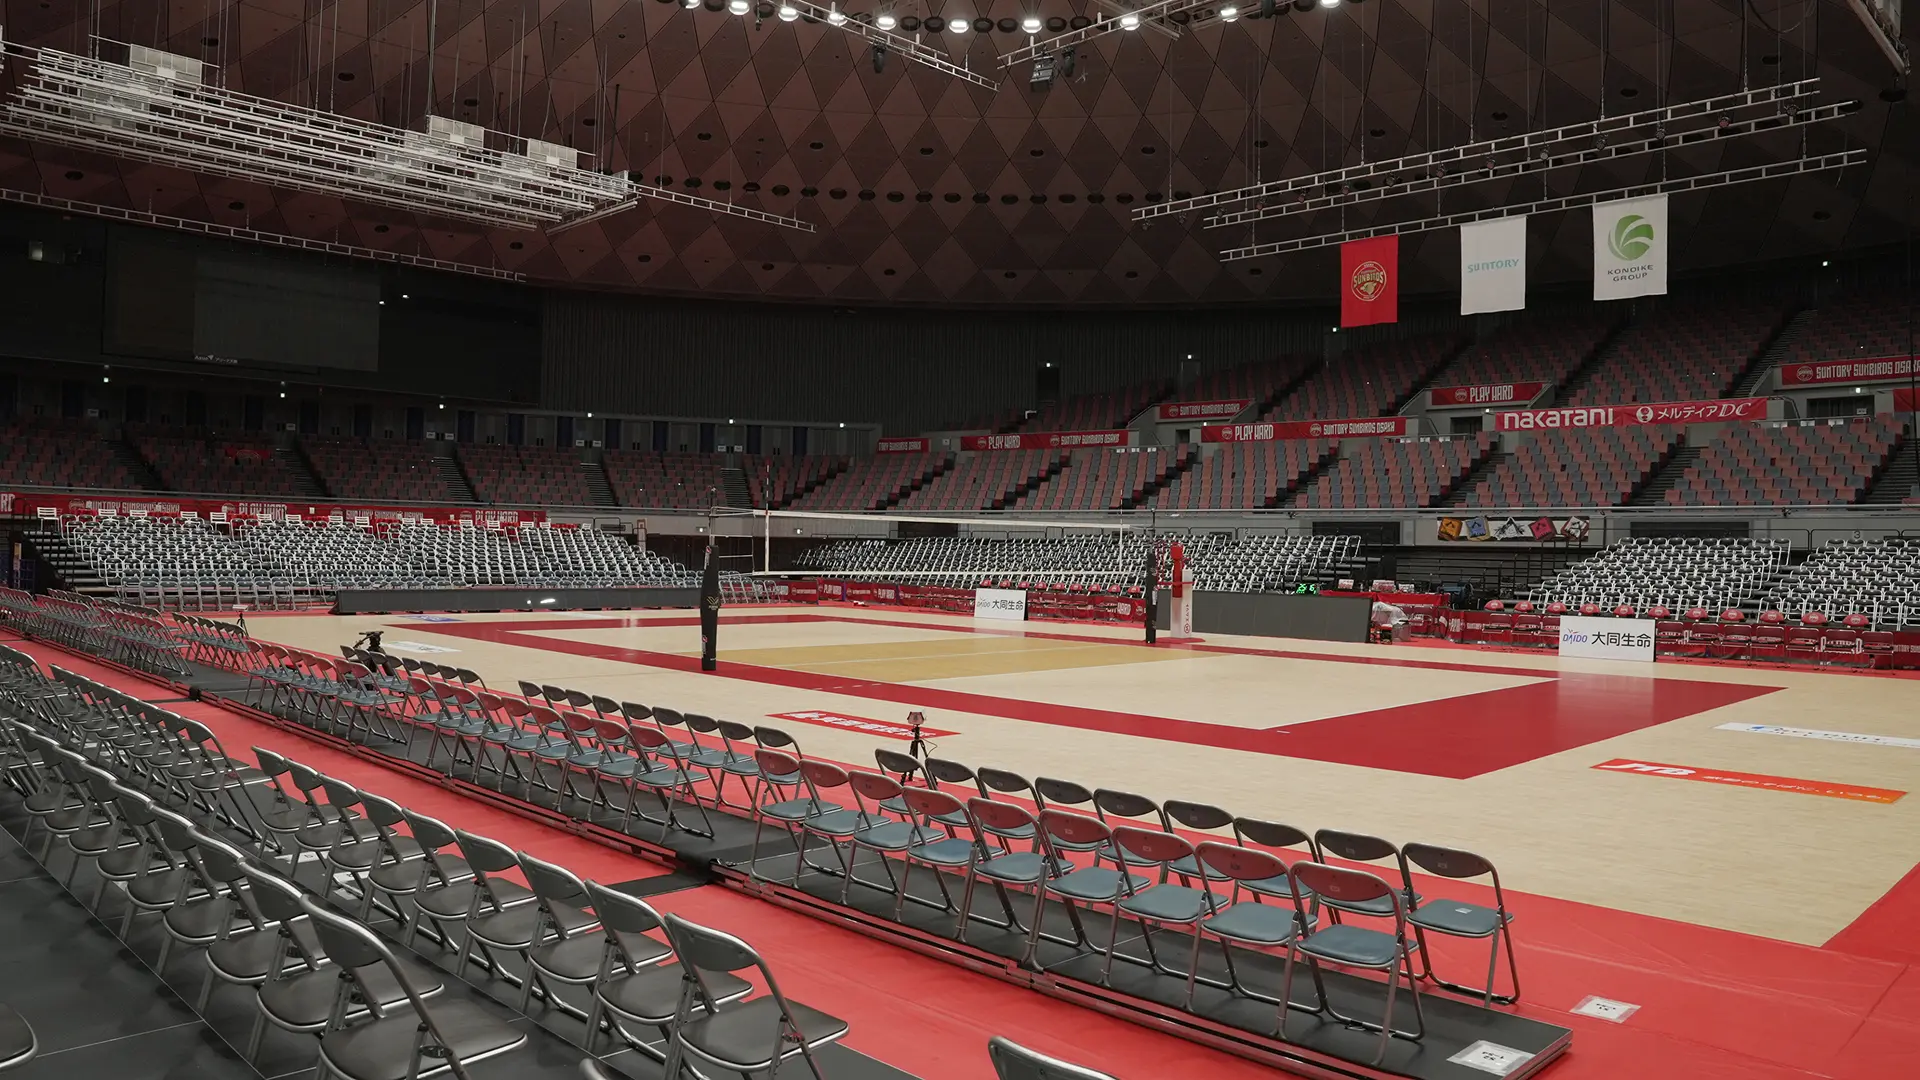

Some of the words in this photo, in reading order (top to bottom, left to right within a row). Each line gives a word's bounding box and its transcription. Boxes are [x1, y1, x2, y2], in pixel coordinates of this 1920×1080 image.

[1607, 264, 1654, 275] KONOIKE
[1612, 272, 1648, 282] GROUP
[1816, 364, 1852, 379] SUNTORY
[1853, 361, 1893, 376] SUNBIRDS
[1470, 386, 1490, 402] PLAY
[1491, 385, 1513, 401] HARD
[1234, 425, 1254, 441] PLAY
[1254, 424, 1274, 440] HARD
[1323, 424, 1349, 436] SUNTORY
[1349, 422, 1376, 434] SUNBIRDS
[1376, 421, 1396, 433] OSAKA
[988, 436, 1004, 449] PLAY
[1004, 435, 1021, 449] HARD
[1853, 530, 1861, 539] 3
[991, 599, 1024, 611] 大同生命
[1591, 631, 1651, 648] 大同生命
